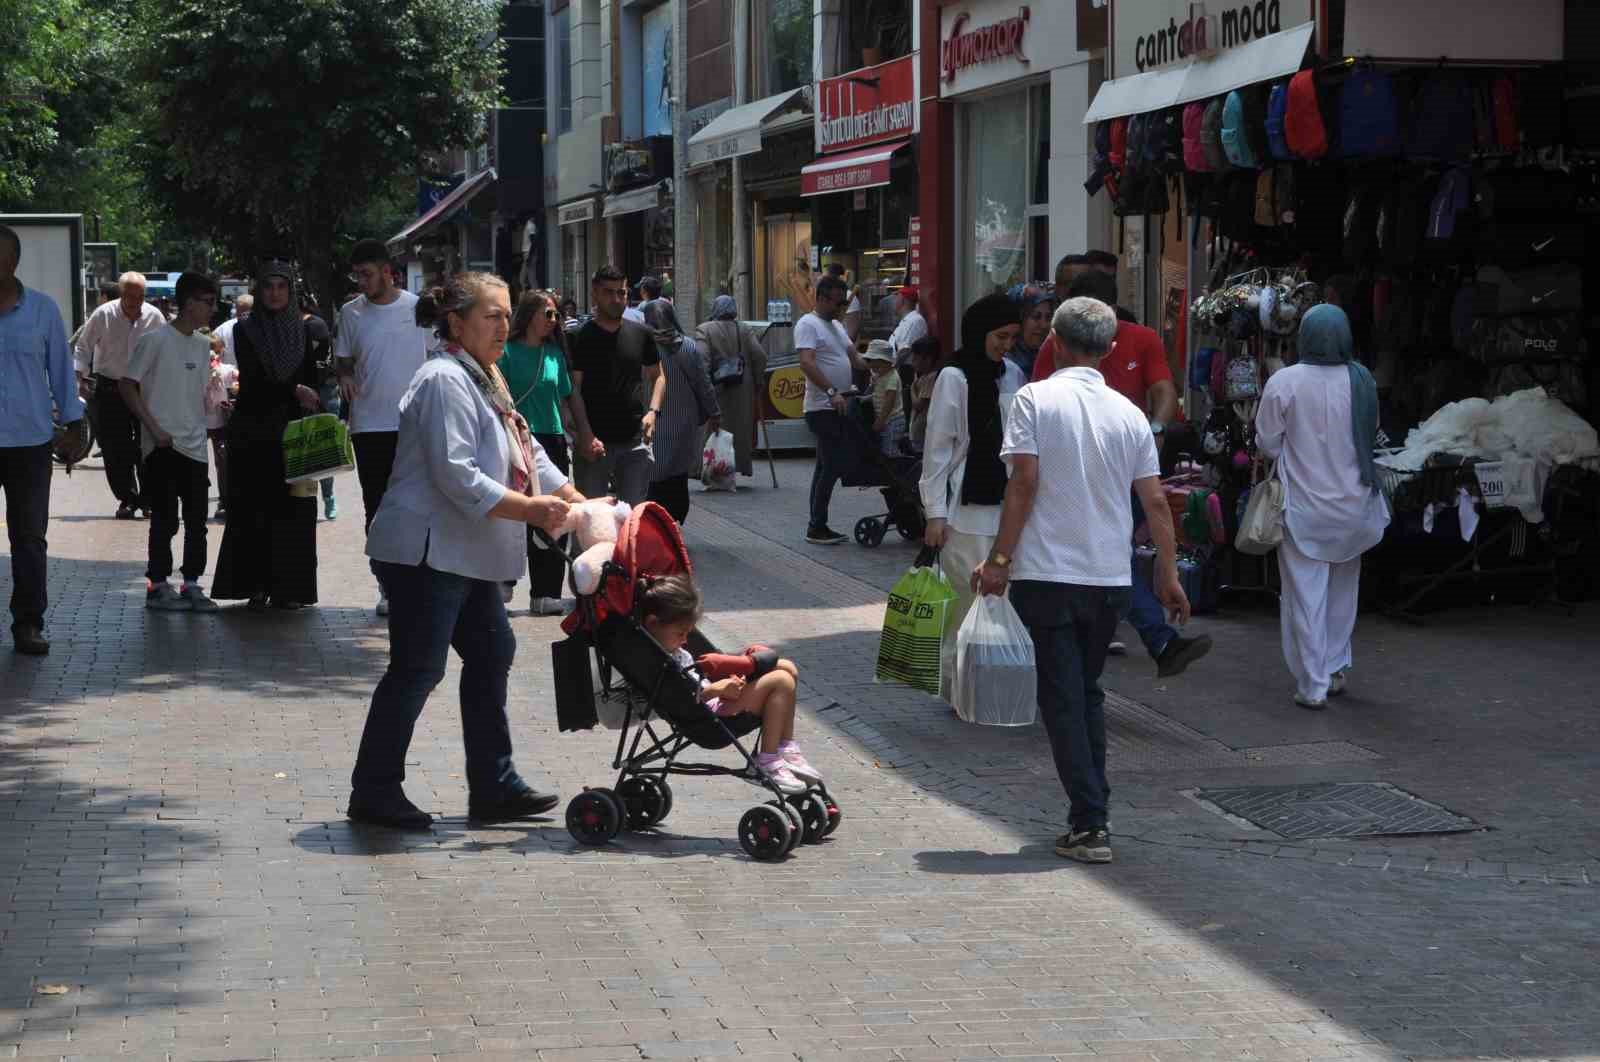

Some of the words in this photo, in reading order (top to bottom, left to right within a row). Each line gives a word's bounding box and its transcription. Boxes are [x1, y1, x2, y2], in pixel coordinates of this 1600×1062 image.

[1222, 0, 1281, 48] moda
[1524, 338, 1557, 349] POLO
[1481, 480, 1503, 495] 200
